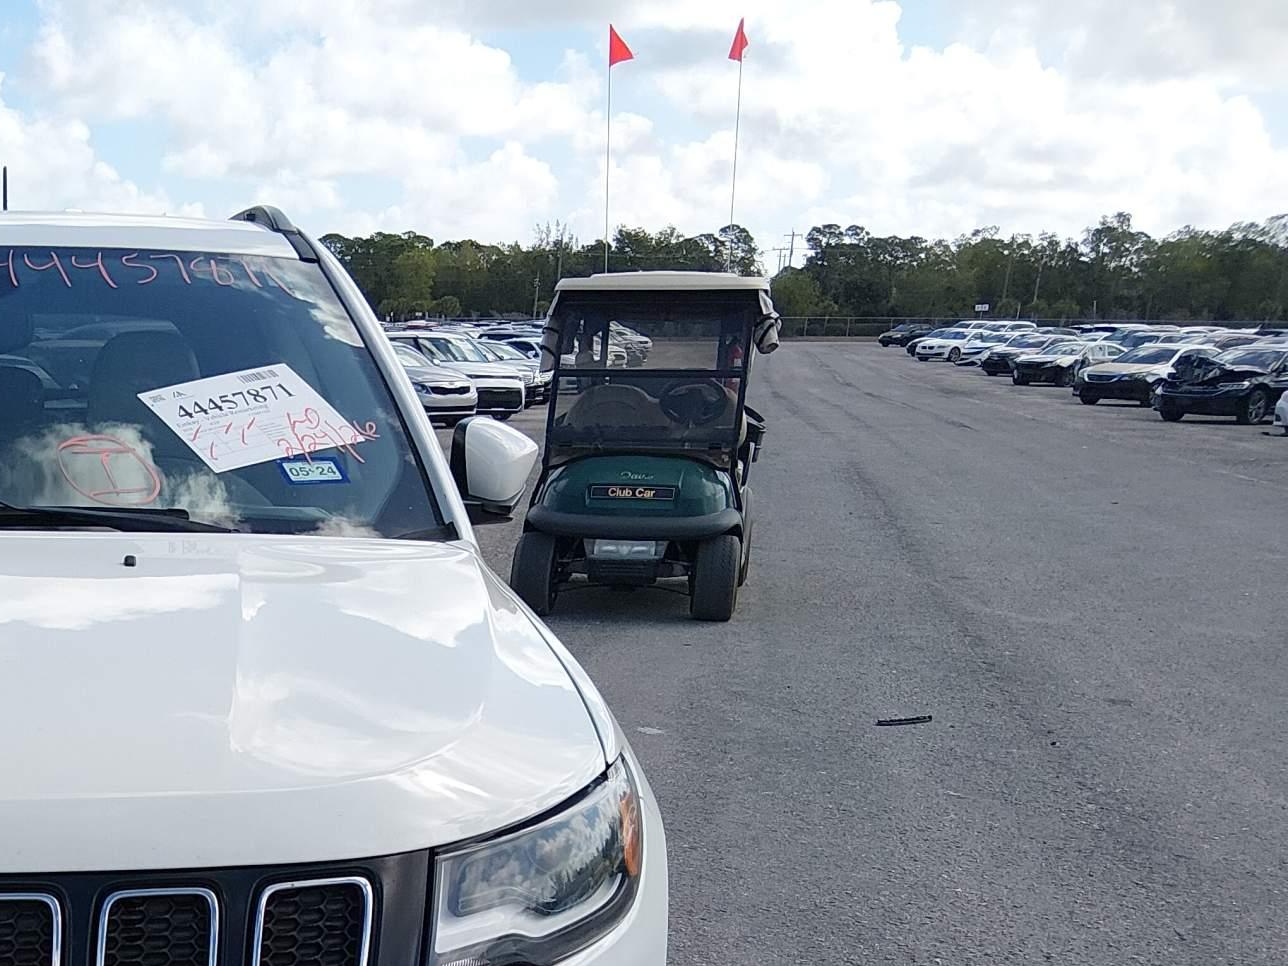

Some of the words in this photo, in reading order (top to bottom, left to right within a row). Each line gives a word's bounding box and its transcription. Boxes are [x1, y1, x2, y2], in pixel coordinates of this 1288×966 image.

[178, 383, 296, 419] 44457871
[608, 487, 632, 497] Club
[635, 488, 656, 498] Car
